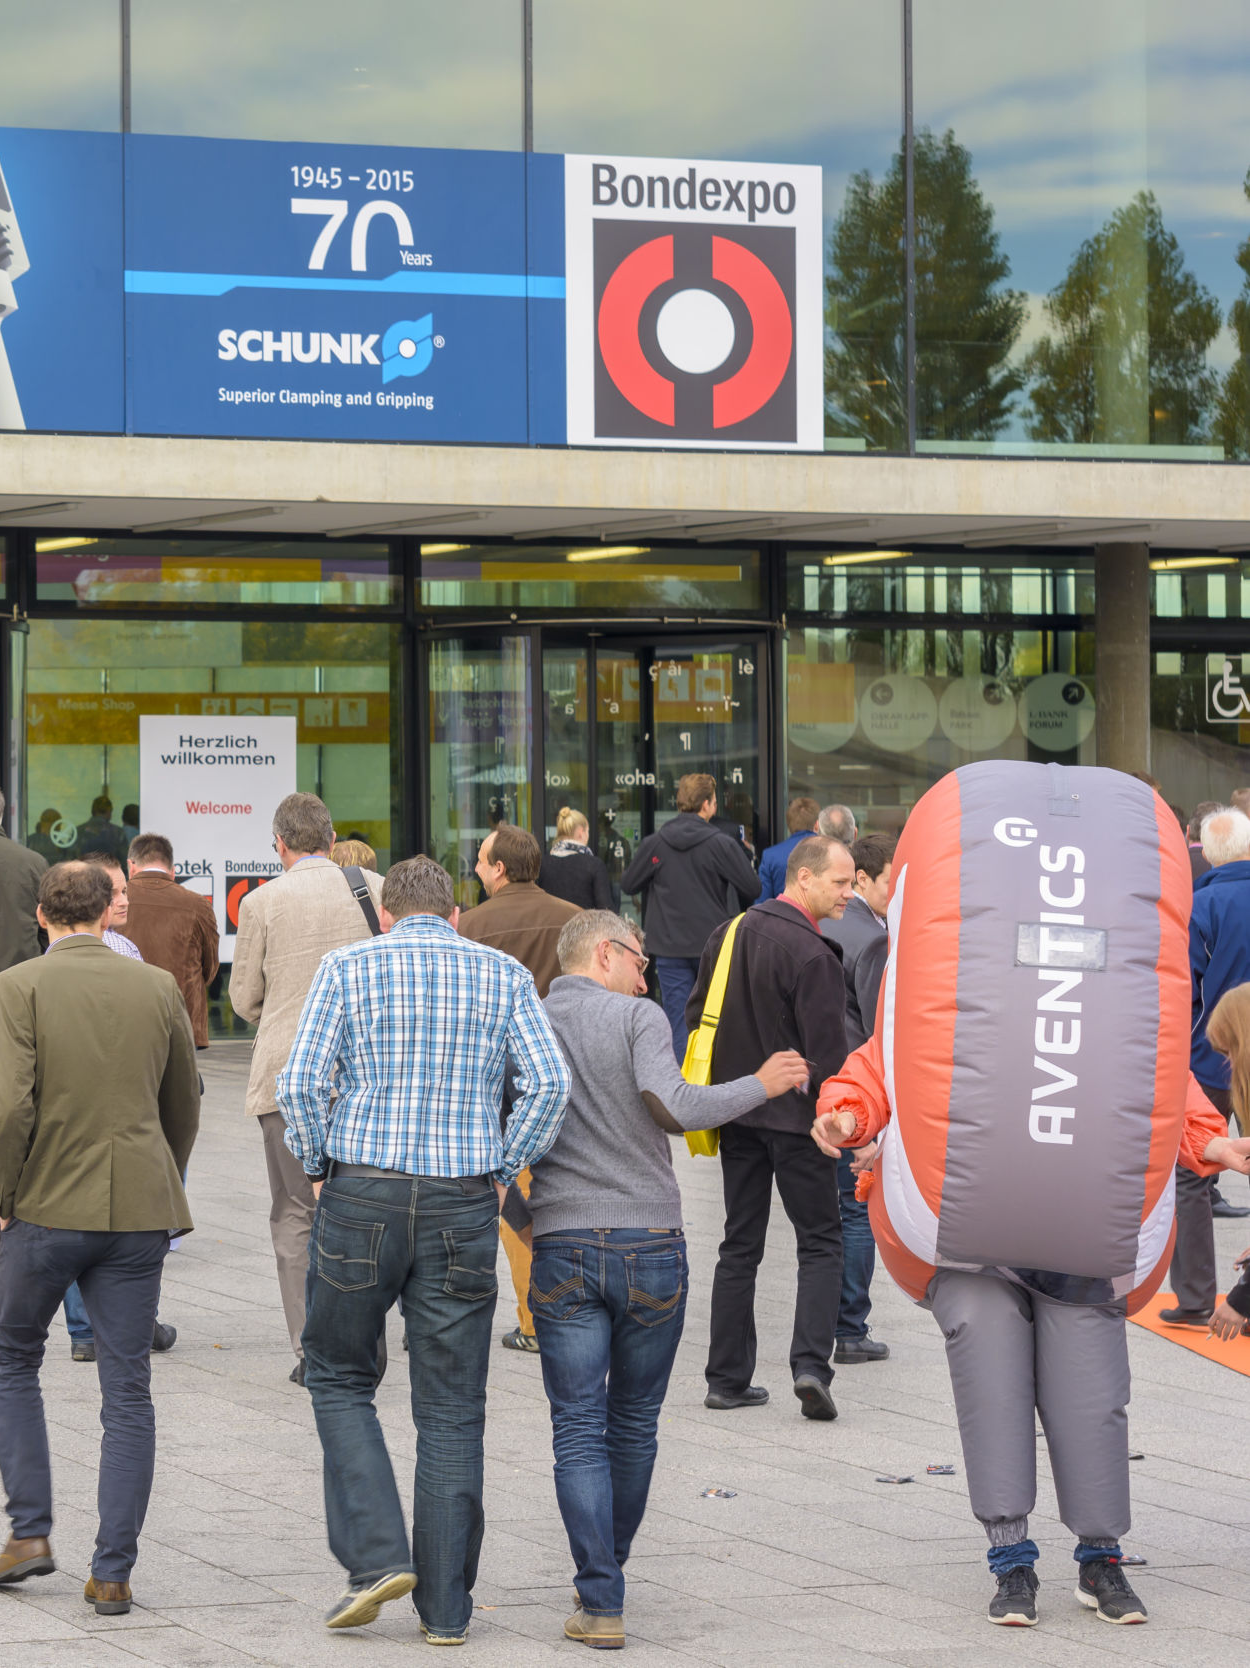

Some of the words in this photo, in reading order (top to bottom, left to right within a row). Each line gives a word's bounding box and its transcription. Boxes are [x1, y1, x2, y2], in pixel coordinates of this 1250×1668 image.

[291, 166, 342, 189] 1945
[365, 169, 414, 192] 2015
[592, 163, 796, 222] Bondexpo
[291, 198, 415, 272] 70
[400, 250, 433, 267] Years
[218, 328, 381, 365] SCHUNK
[219, 387, 275, 406] Superior
[279, 389, 342, 408] Clamping
[346, 391, 372, 405] and
[376, 392, 434, 410] Gripping
[179, 734, 258, 749] Herzlich
[160, 751, 276, 766] willkommen
[185, 801, 252, 816] Welcome
[174, 859, 213, 875] otek
[225, 860, 283, 874] Bondexpo
[1028, 844, 1086, 1145] AVENTICS
